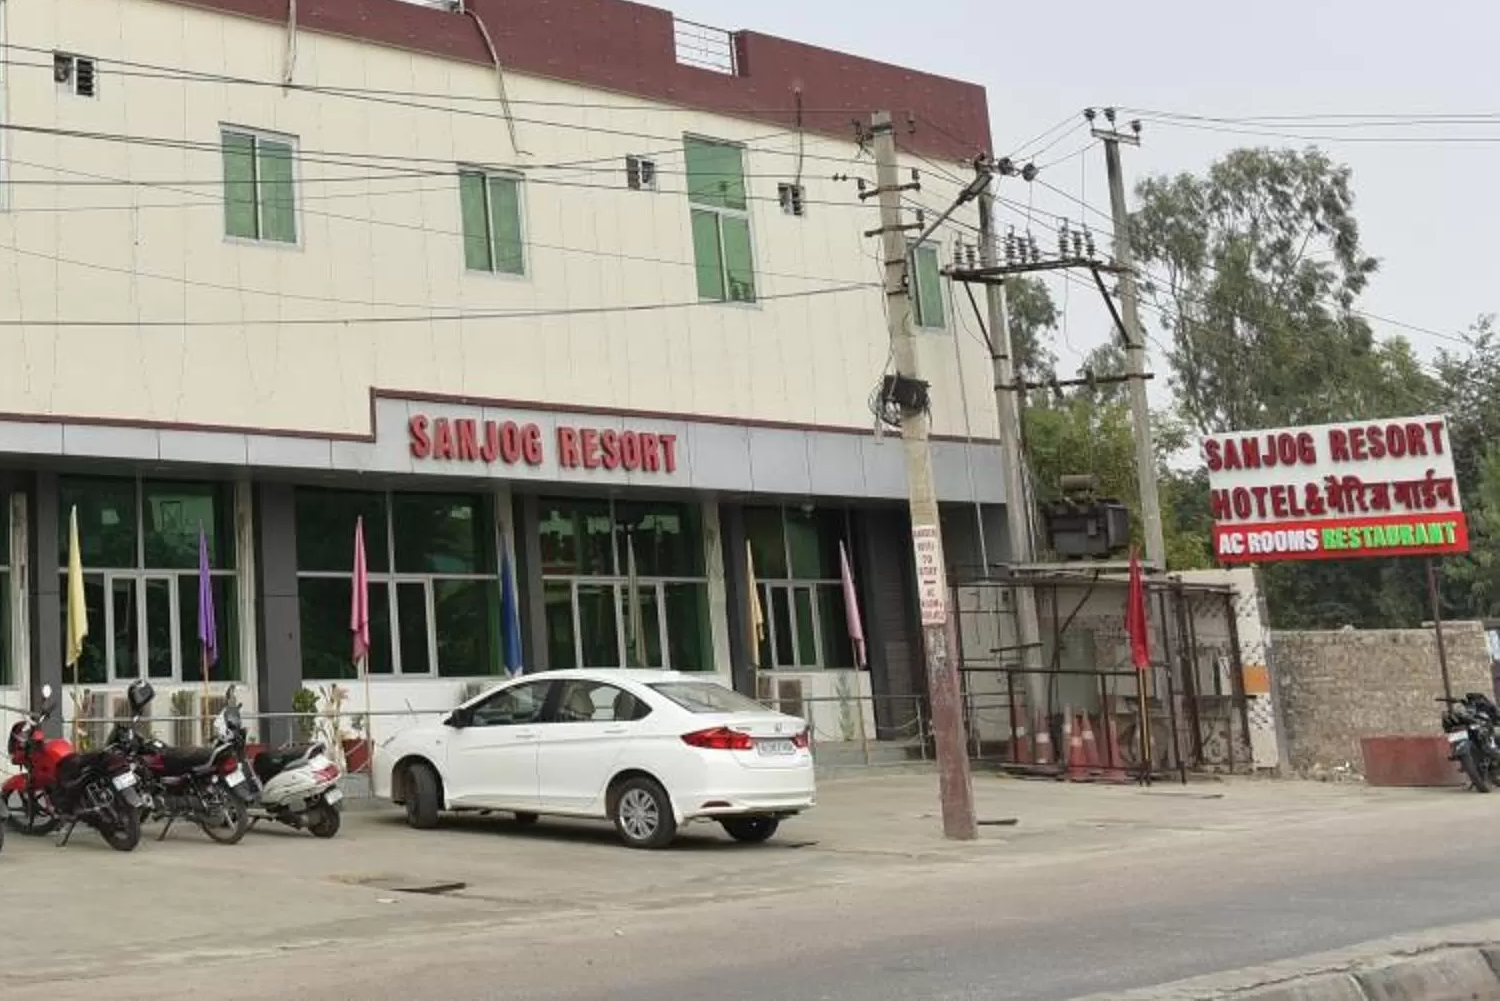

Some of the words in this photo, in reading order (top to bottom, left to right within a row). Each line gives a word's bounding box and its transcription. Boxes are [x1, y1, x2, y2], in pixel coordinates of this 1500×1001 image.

[409, 414, 544, 467] SANJOG
[556, 426, 677, 473] RESORT
[1204, 432, 1317, 472] SANJOG
[1328, 421, 1445, 463] RESORT
[1219, 533, 1244, 555] AC
[1248, 528, 1318, 554] ROOMS
[1321, 521, 1457, 550] RESTAURANT
